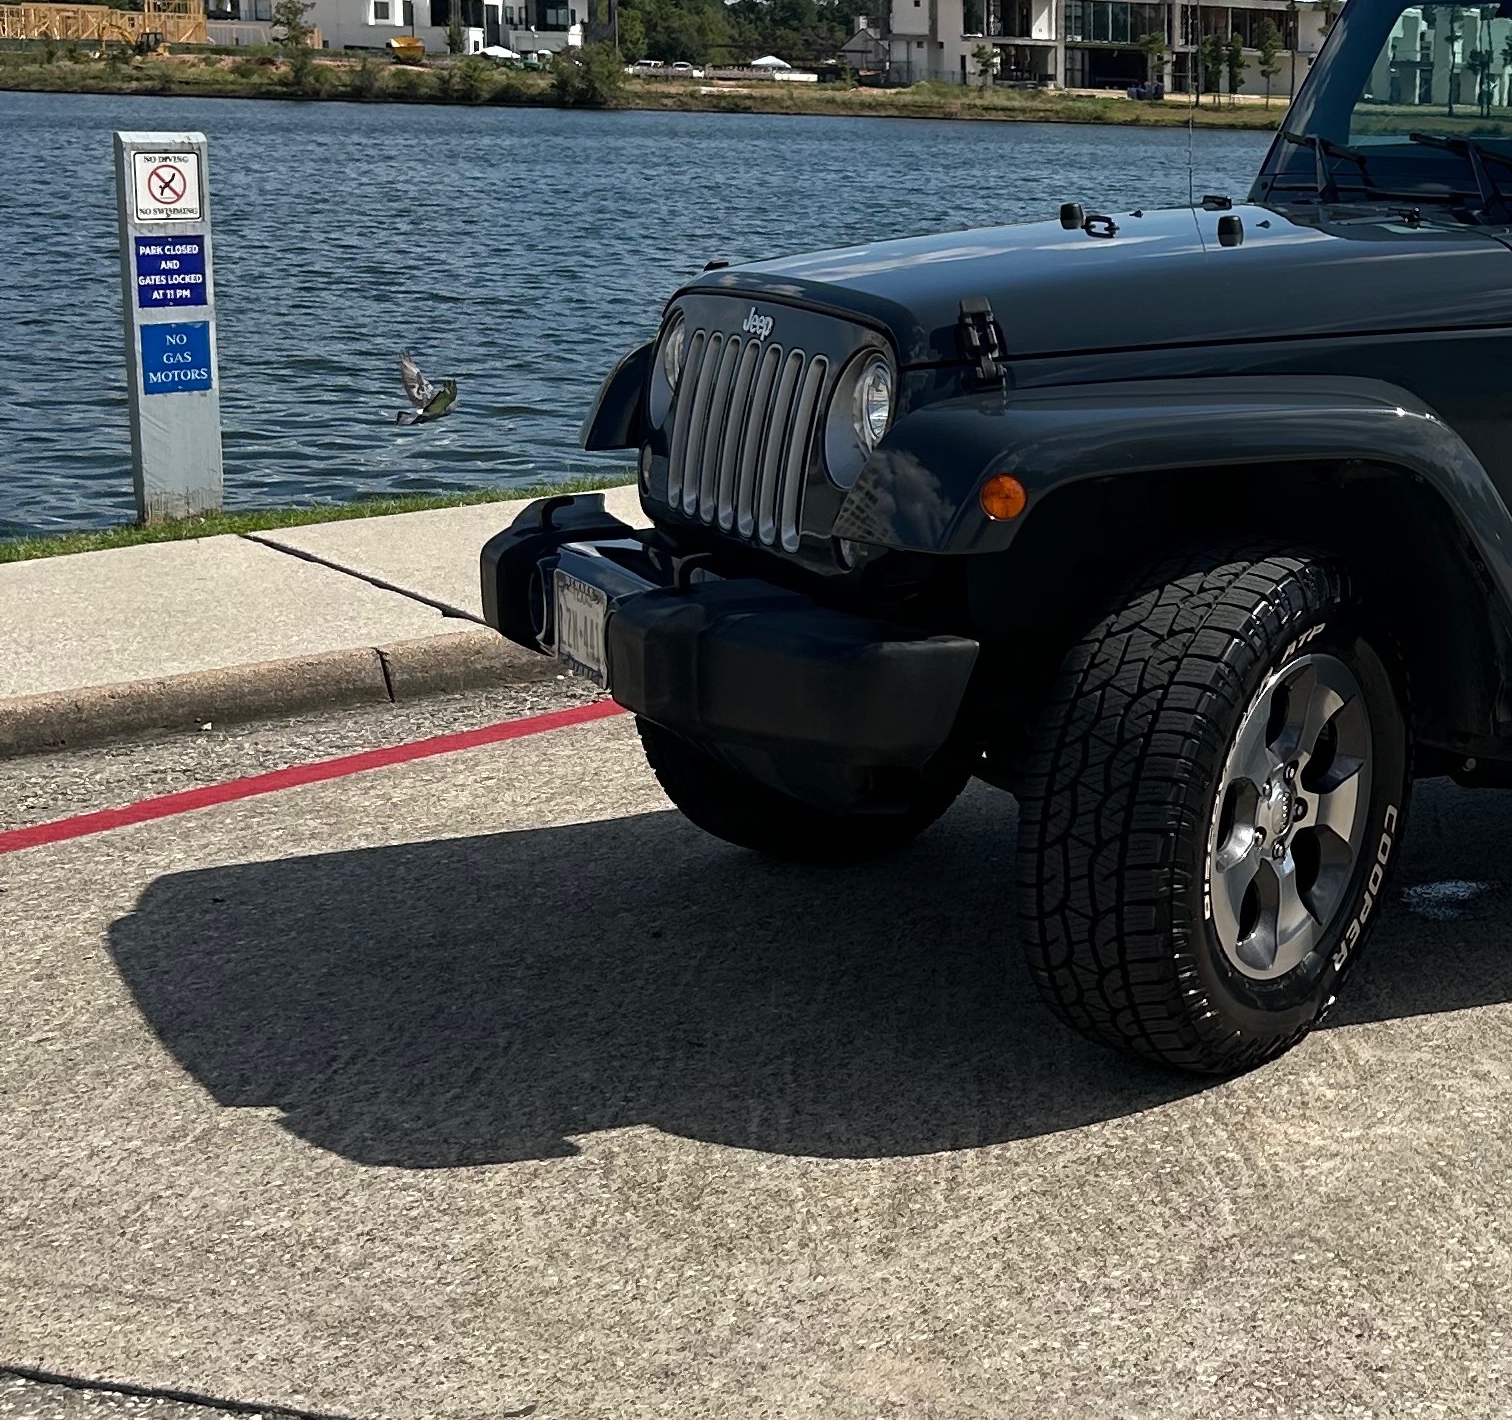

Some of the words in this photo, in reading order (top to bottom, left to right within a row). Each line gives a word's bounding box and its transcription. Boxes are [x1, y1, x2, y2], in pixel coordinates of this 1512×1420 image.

[140, 245, 163, 255] PARK
[165, 244, 199, 254] CLOSED
[160, 260, 180, 270] AND
[139, 275, 167, 285] GATES
[168, 274, 203, 284] LOCKED
[152, 290, 164, 300] AT
[166, 289, 175, 299] 11
[177, 289, 191, 299] PM
[743, 306, 774, 341] Jeep
[165, 334, 187, 346] NO
[163, 351, 192, 364] GAS
[149, 368, 208, 384] MOTORS
[1332, 804, 1398, 972] COOPER
